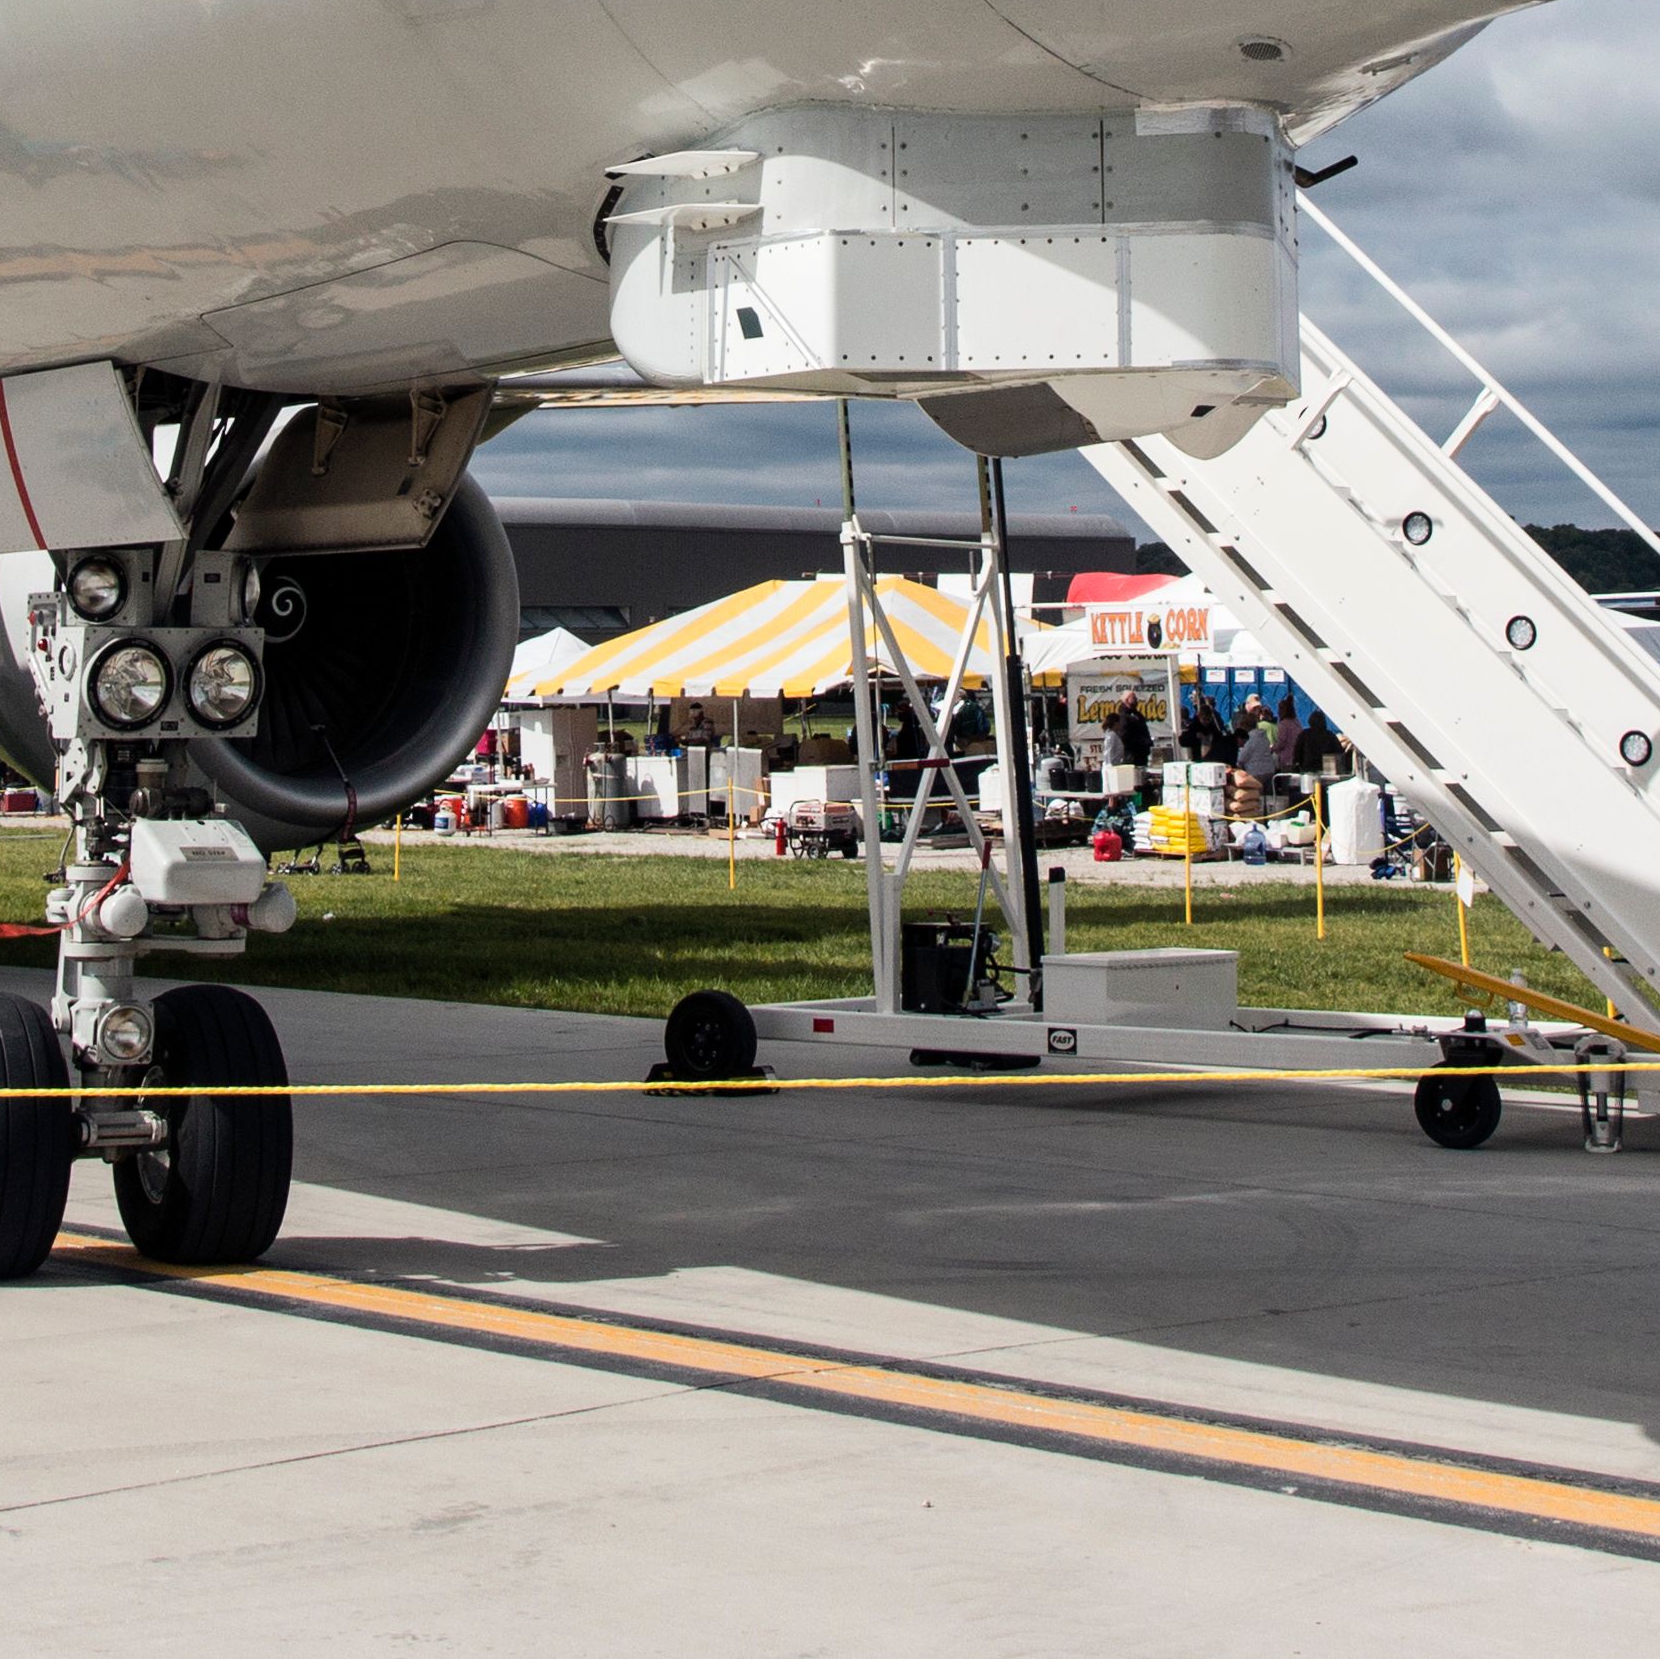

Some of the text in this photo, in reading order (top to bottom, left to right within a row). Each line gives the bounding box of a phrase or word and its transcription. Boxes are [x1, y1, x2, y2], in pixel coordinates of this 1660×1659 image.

[1091, 608, 1210, 644] KETTLE CORN
[1080, 684, 1165, 694] FRESH SQUEEZED
[1052, 1035, 1073, 1044] FAST
